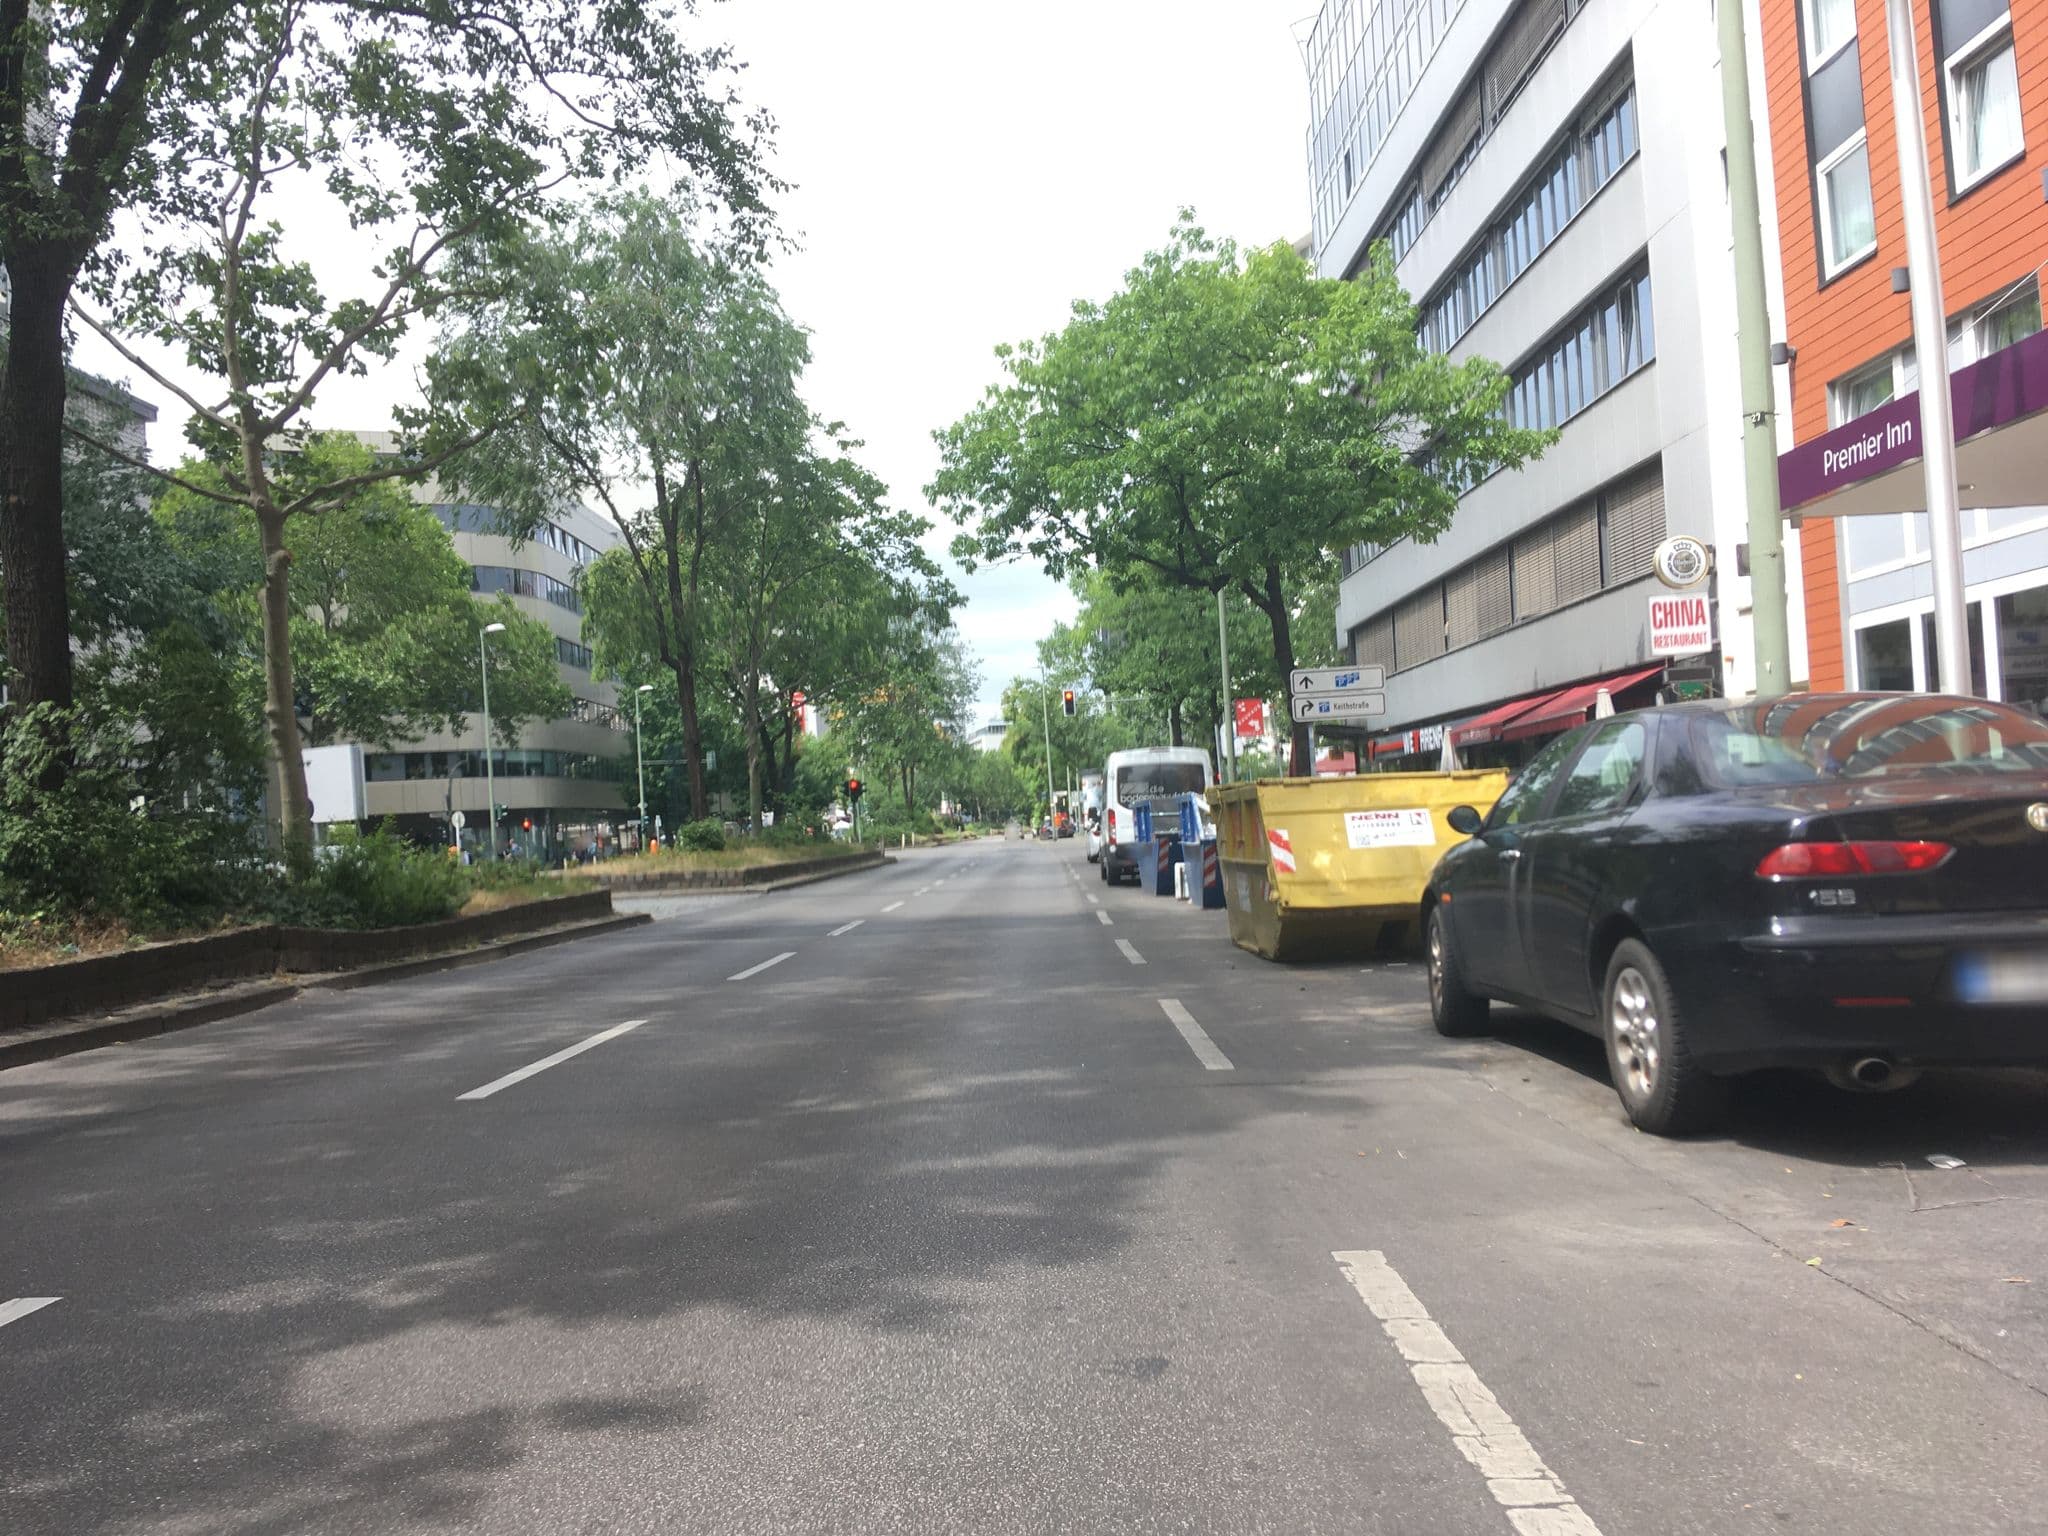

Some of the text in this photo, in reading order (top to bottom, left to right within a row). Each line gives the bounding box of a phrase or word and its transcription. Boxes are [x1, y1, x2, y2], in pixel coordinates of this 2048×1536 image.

[1752, 412, 1761, 423] 27
[1823, 419, 1912, 476] Premier Inn
[1651, 598, 1706, 629] CHINA
[1653, 631, 1708, 649] RESTAURANT
[1333, 701, 1370, 711] Keithstraße
[1351, 812, 1399, 821] NENN
